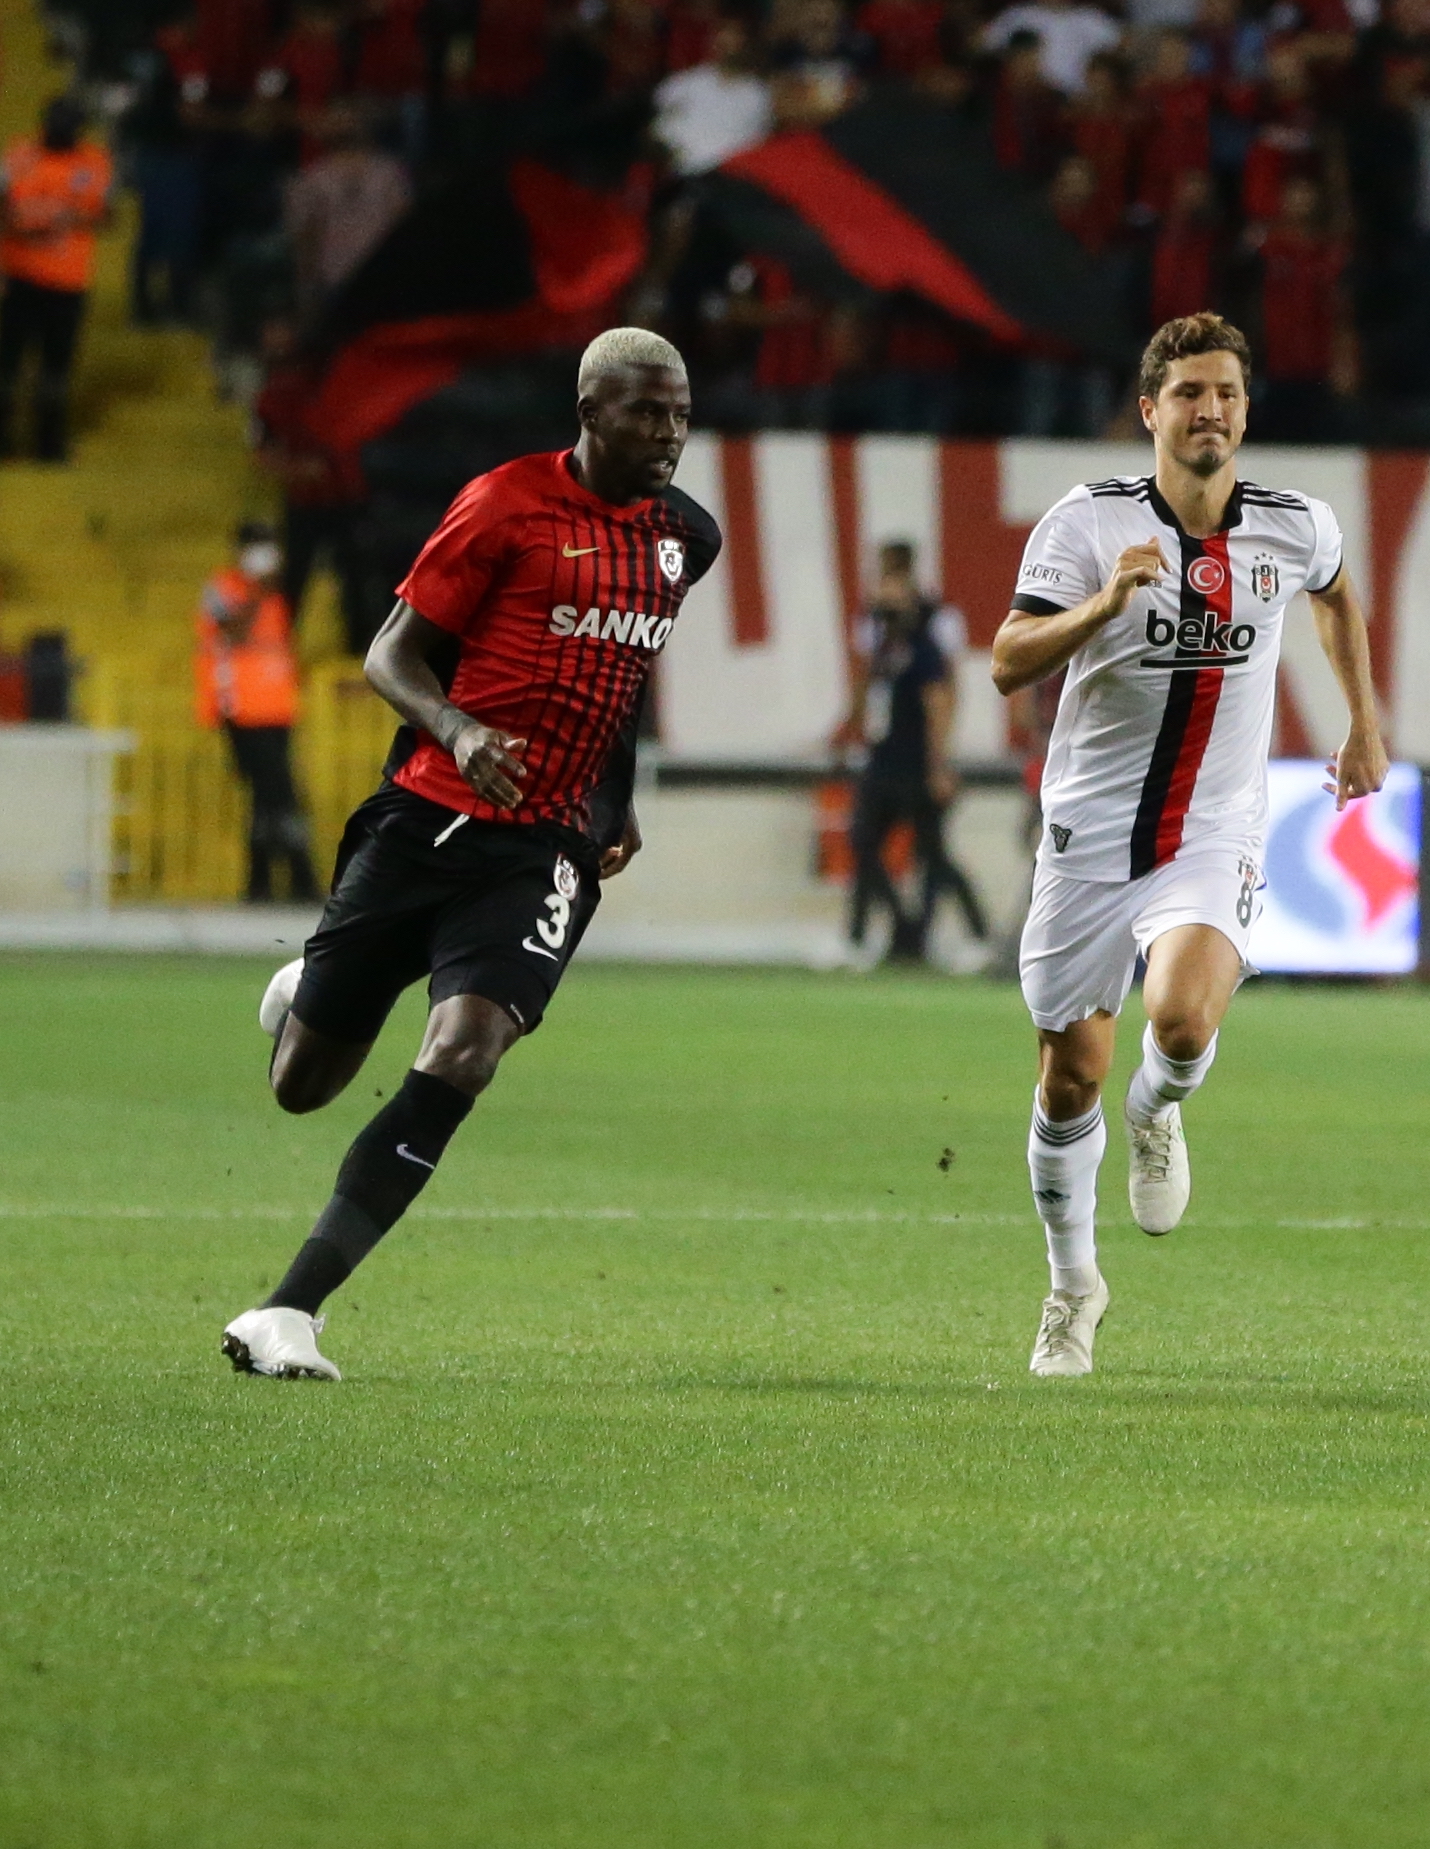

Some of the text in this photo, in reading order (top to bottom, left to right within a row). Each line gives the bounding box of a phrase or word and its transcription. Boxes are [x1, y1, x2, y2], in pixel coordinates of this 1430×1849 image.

[549, 604, 674, 650] SANKO
[1145, 609, 1257, 652] beko
[536, 893, 570, 949] 3
[1236, 880, 1253, 929] 8
